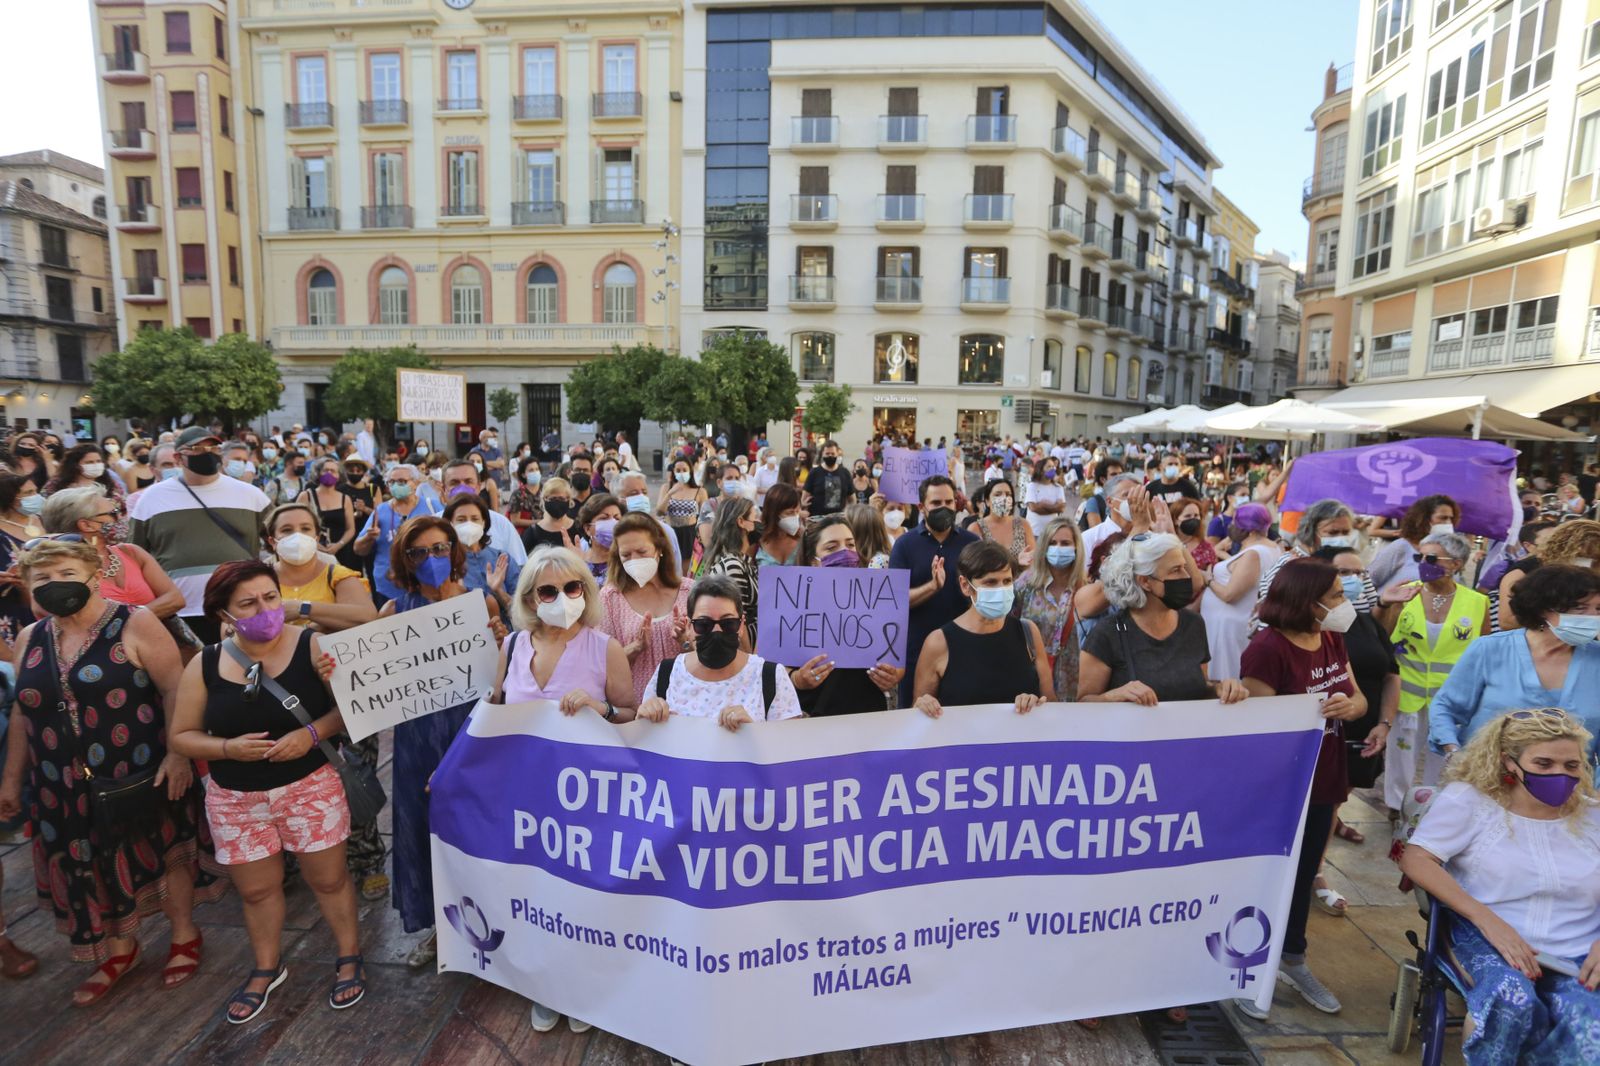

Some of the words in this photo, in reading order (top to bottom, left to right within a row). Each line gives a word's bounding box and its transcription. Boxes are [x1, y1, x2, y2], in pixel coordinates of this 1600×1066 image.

[404, 400, 458, 417] GRITARIAS
[833, 575, 898, 610] UNA
[332, 625, 421, 665] BASTA
[432, 610, 465, 632] DE
[779, 612, 873, 649] MENOS
[350, 633, 487, 691] ASESINATOS
[351, 700, 364, 714] A
[368, 675, 453, 710] MUJERES
[456, 664, 472, 689] Y
[557, 766, 674, 829] OTRA
[692, 778, 861, 833] MUJER
[878, 763, 1158, 817] ASESINADA
[514, 809, 593, 872] POR
[609, 831, 666, 881] LA
[678, 826, 949, 891] VIOLENCIA
[966, 811, 1204, 863] MACHISTA
[510, 898, 616, 948] Plataforma
[623, 930, 688, 969] contra
[696, 946, 730, 974] los
[738, 938, 809, 972] malos
[817, 931, 887, 958] tratos
[894, 932, 906, 951] a
[913, 917, 1000, 949] mujeres
[1025, 906, 1142, 936] VIOLENCIA
[1148, 898, 1203, 926] CERO
[813, 963, 912, 997] MÁLAGA
